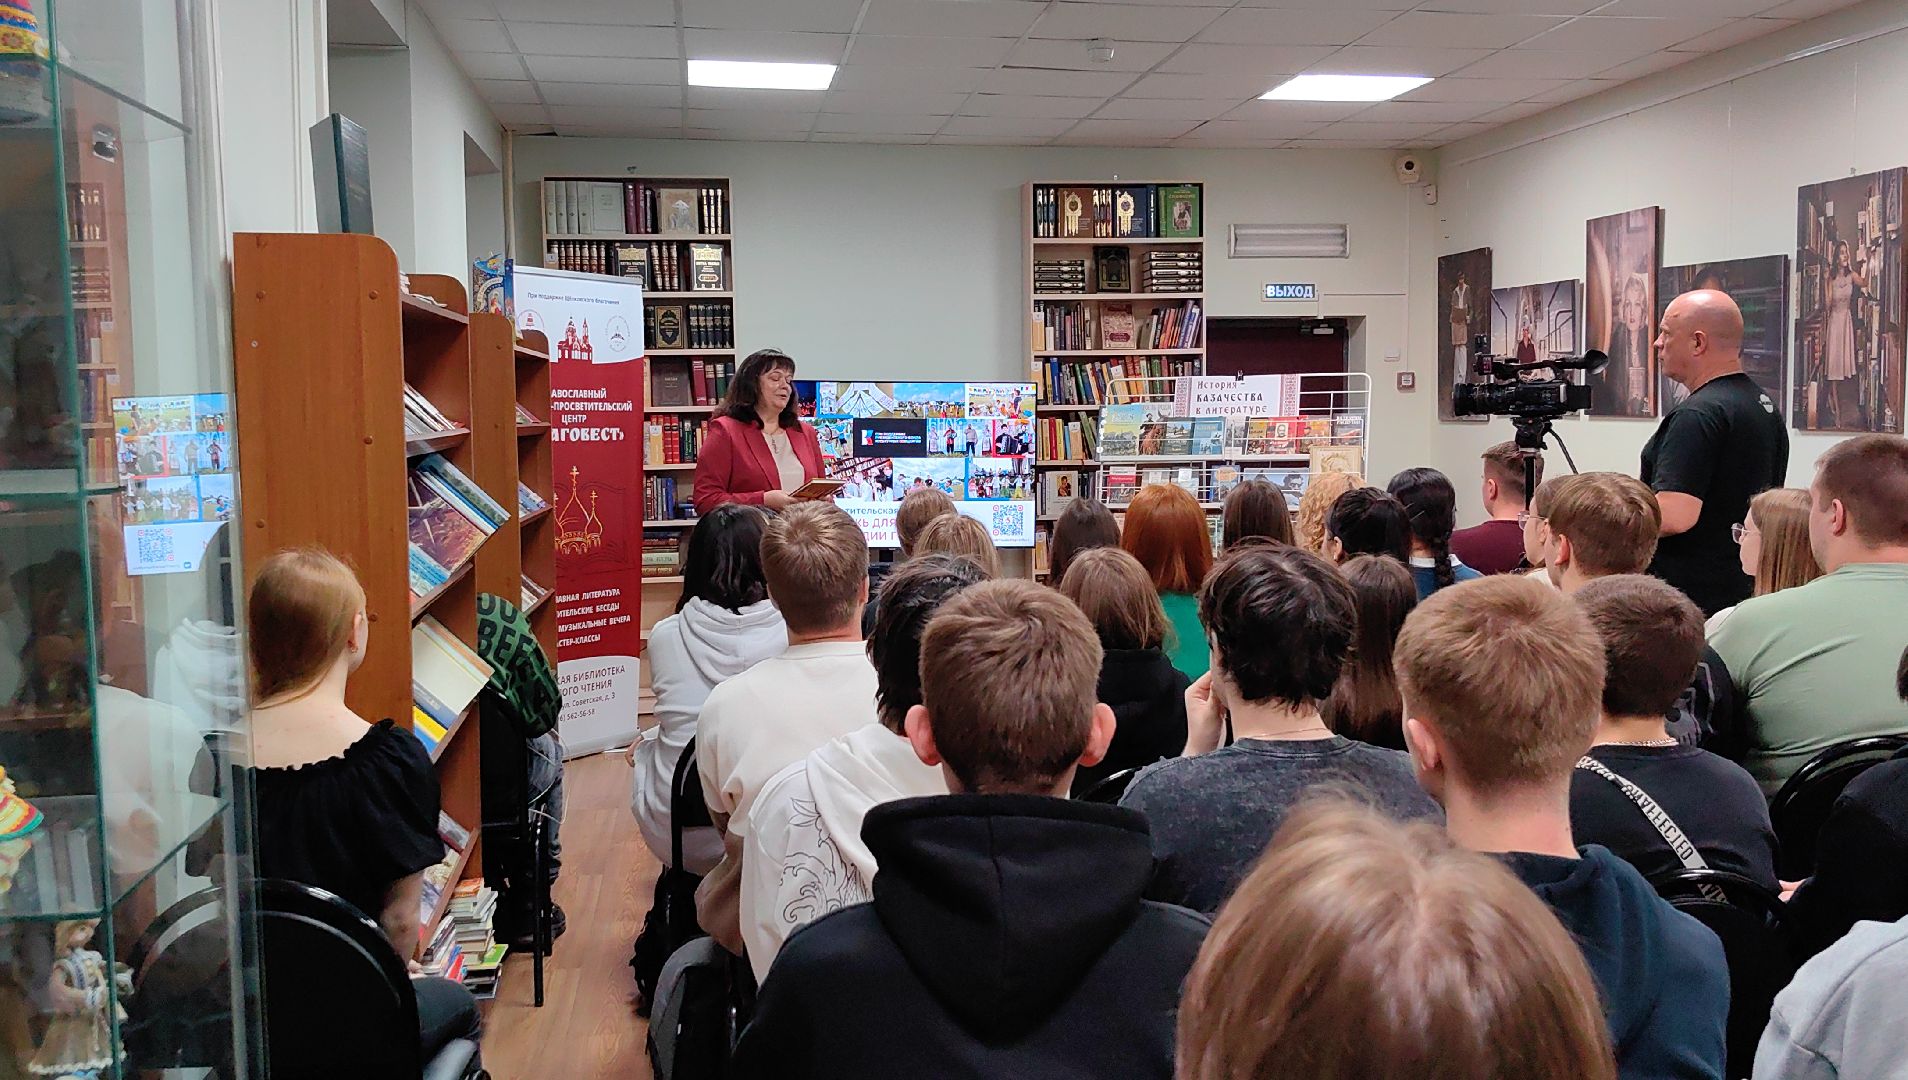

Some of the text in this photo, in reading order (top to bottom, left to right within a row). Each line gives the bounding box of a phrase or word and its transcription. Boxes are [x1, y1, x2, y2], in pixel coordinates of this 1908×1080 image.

[1266, 286, 1313, 298] ВЫХОД
[1197, 380, 1237, 390] История
[551, 388, 607, 399] АВОСЛАВНЫЙ
[1196, 392, 1263, 402] КАЗАЧЕСТВА
[551, 400, 633, 411] -ПРОСВЕТИТЕЛЬСКИЙ
[561, 414, 587, 425] ЦЕНТР
[872, 518, 897, 529] ДЛЯ
[581, 588, 621, 601] ЛИТЕРАТУРА
[595, 602, 620, 613] БЕСЕДЫ
[558, 615, 631, 633] МУЗЫКАЛЬНЫЕ ВЕЧЕРА
[556, 633, 601, 648] СТЕР-КЛАССЫ
[573, 665, 626, 683] БИБЛИОТЕКА
[560, 679, 612, 697] ОГО ЧТЕНИЯ
[611, 691, 616, 699] 3
